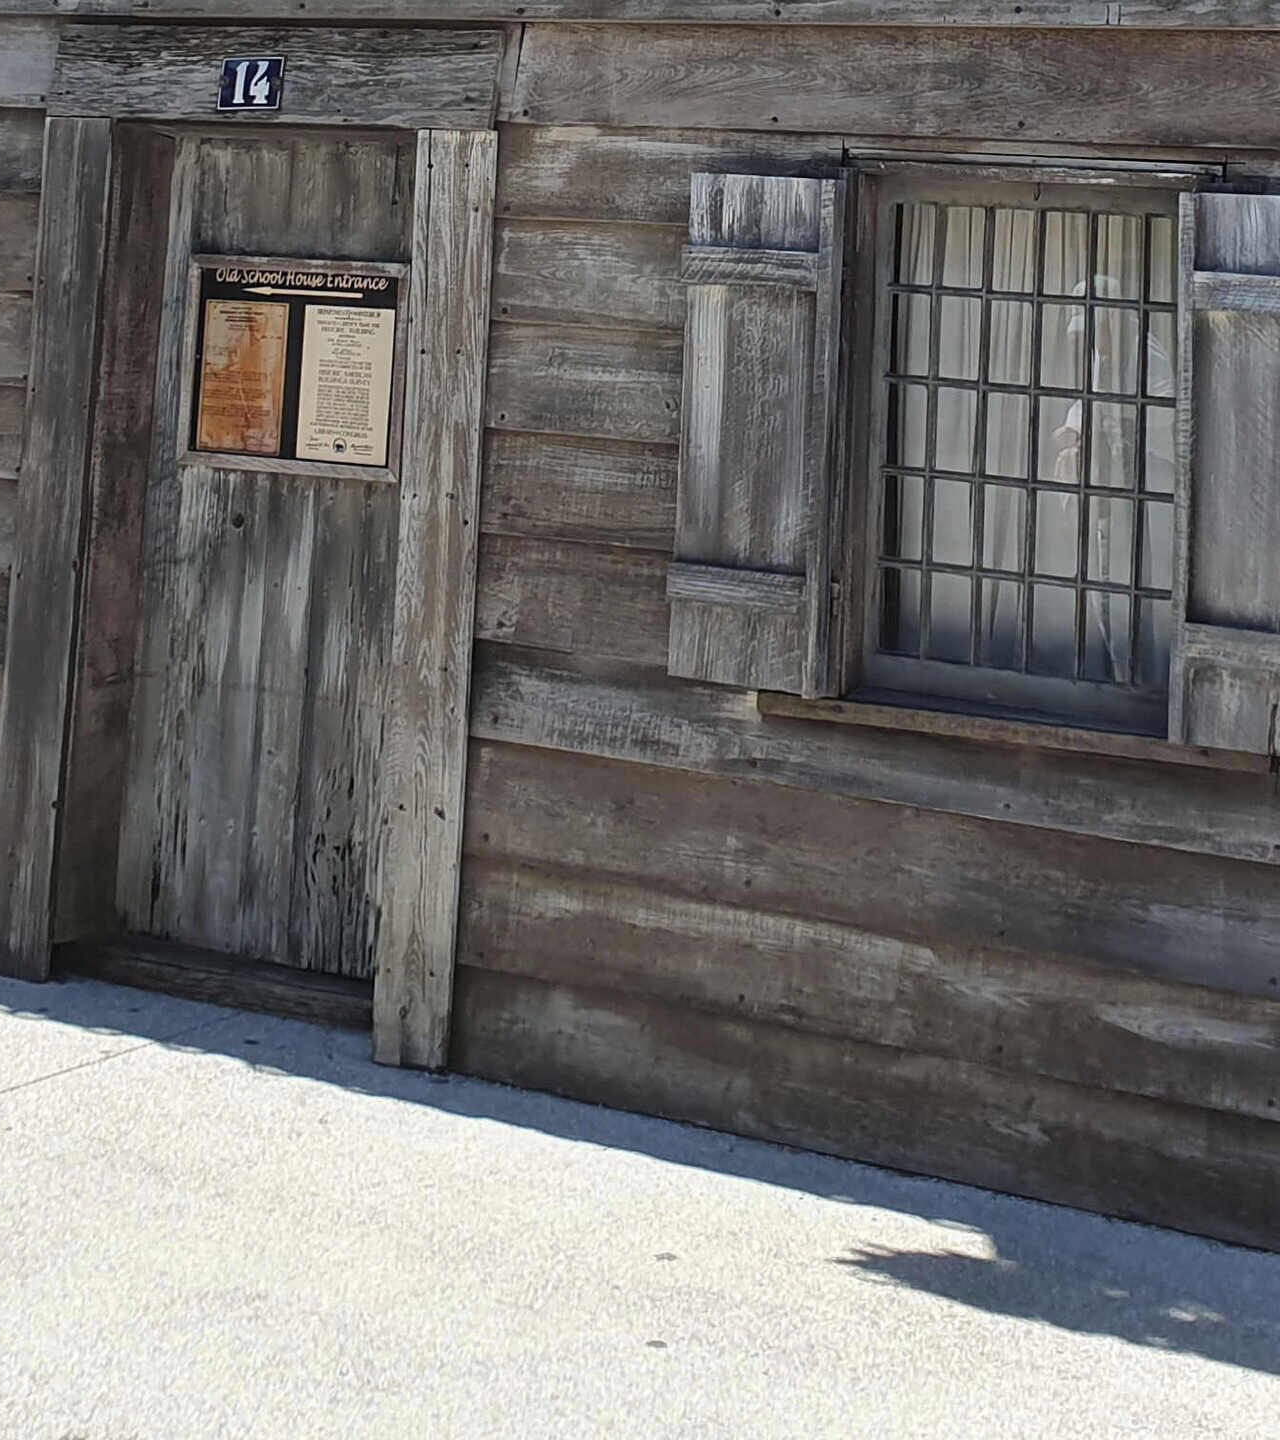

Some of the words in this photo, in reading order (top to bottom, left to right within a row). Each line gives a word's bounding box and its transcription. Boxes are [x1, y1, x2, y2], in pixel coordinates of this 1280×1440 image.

[232, 61, 270, 104] 14
[215, 267, 241, 283] Old
[241, 271, 285, 286] School
[285, 273, 326, 288] House
[327, 274, 389, 291] Entrance
